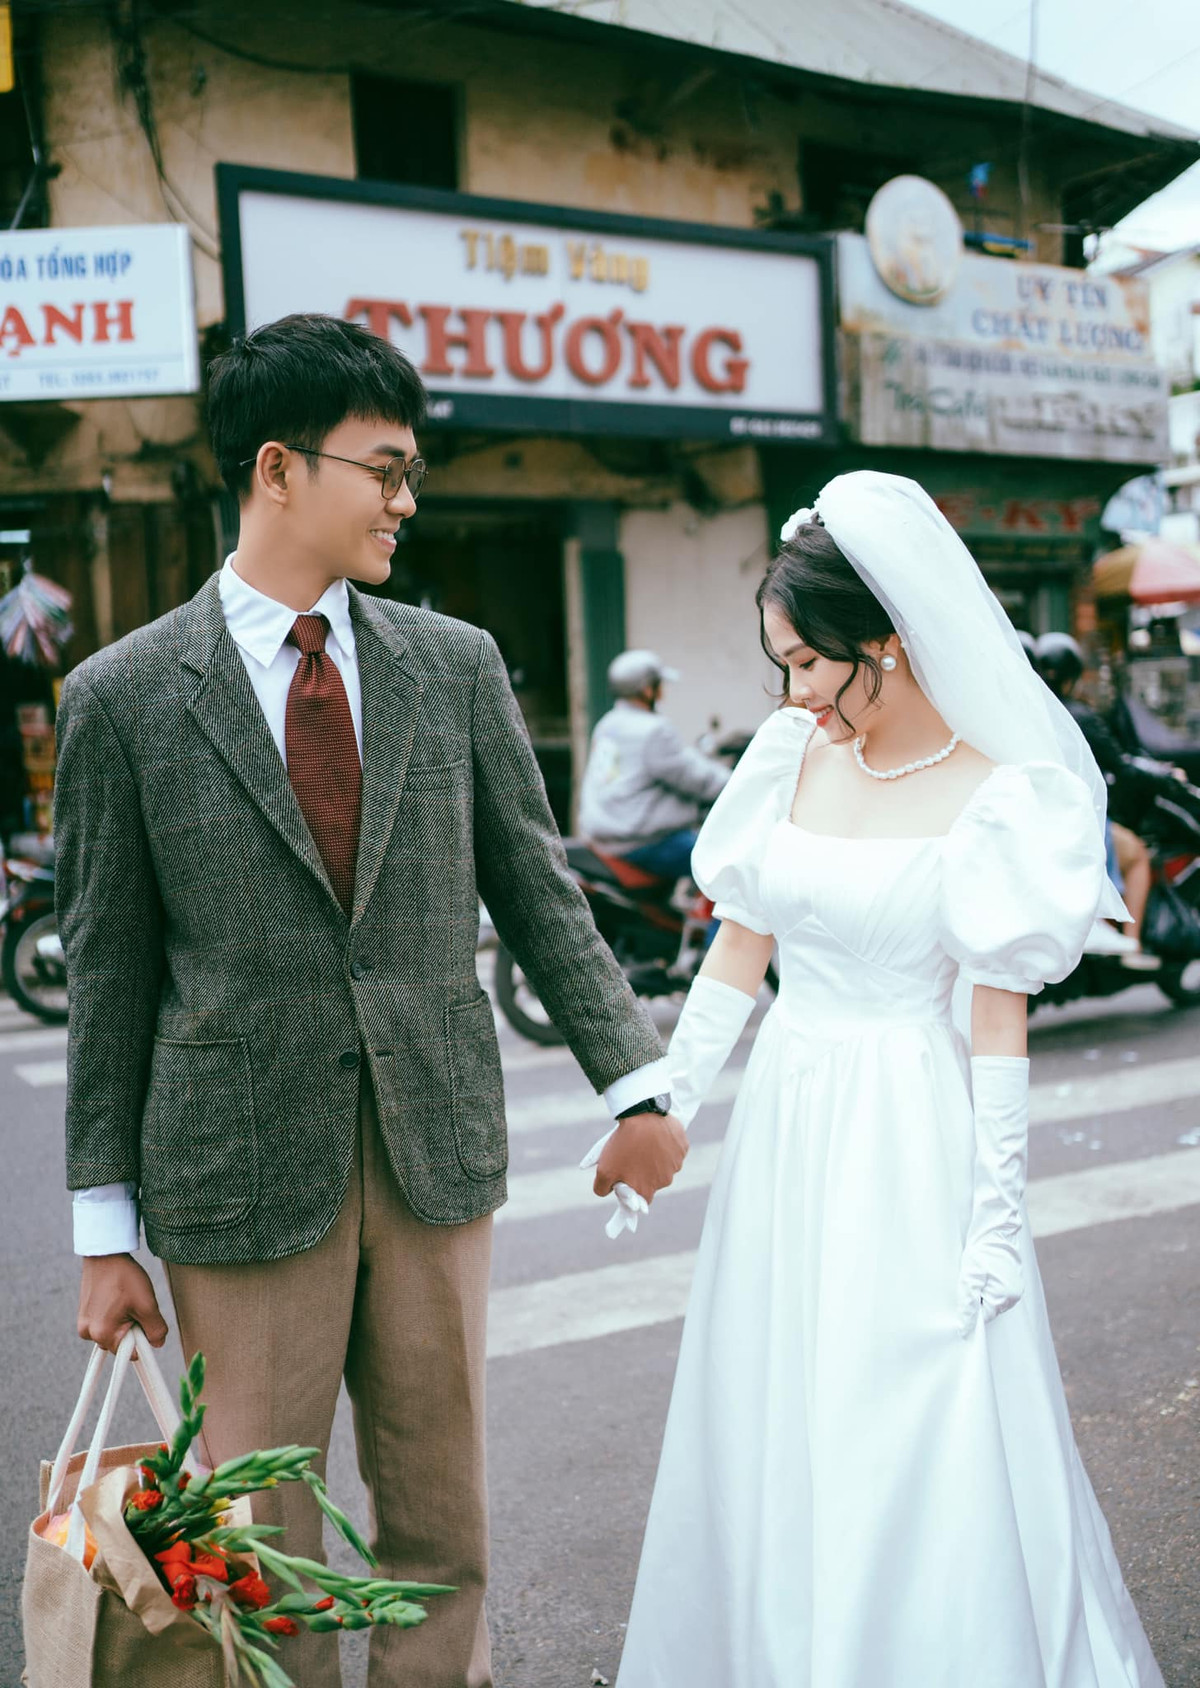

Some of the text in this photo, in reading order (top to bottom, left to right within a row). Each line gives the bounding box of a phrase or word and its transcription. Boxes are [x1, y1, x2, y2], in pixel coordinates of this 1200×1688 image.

[94, 250, 132, 284] HỢP
[460, 228, 648, 293] Tiệm Vàng
[344, 296, 749, 394] THƯƠNG
